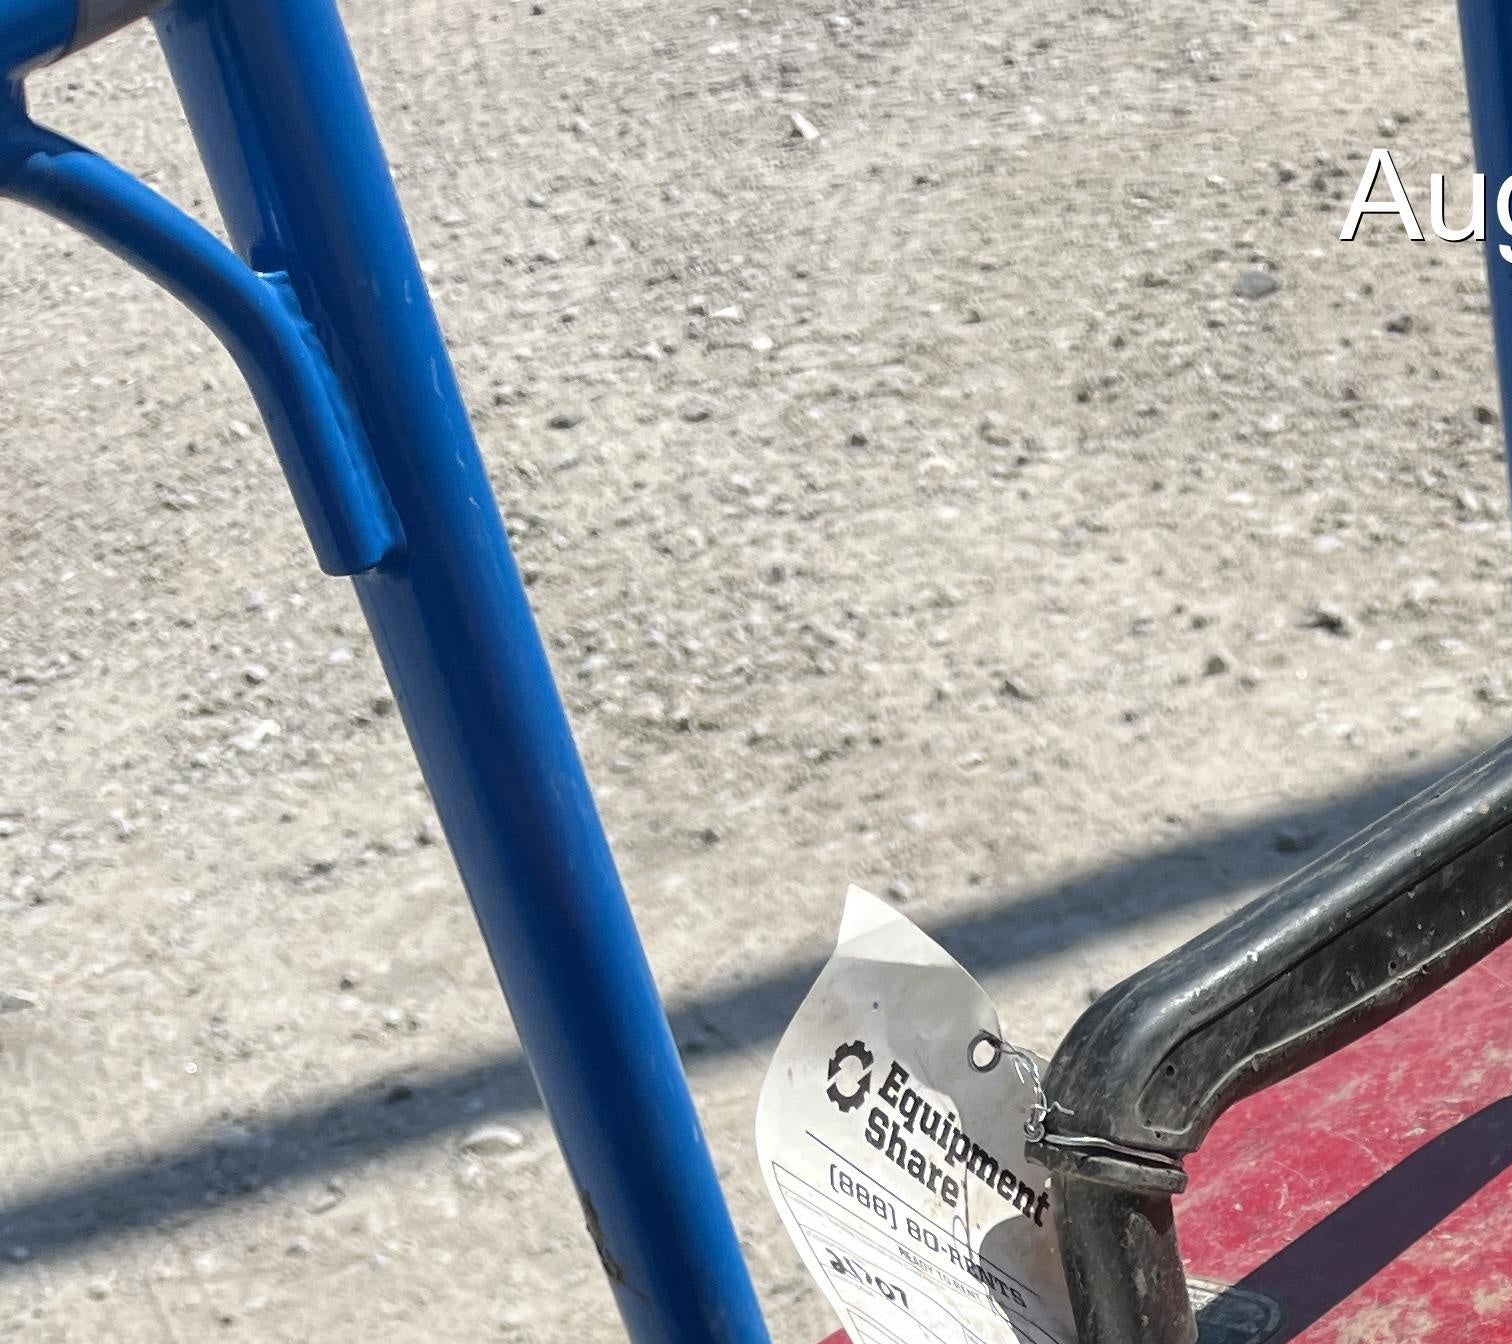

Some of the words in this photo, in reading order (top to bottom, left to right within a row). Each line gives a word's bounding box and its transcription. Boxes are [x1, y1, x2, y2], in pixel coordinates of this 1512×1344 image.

[864, 1106, 964, 1208] Share
[877, 1060, 1050, 1228] Equipment
[829, 1163, 898, 1231] (888)
[906, 1216, 1028, 1309] 80-RENTS
[898, 1245, 935, 1274] READY
